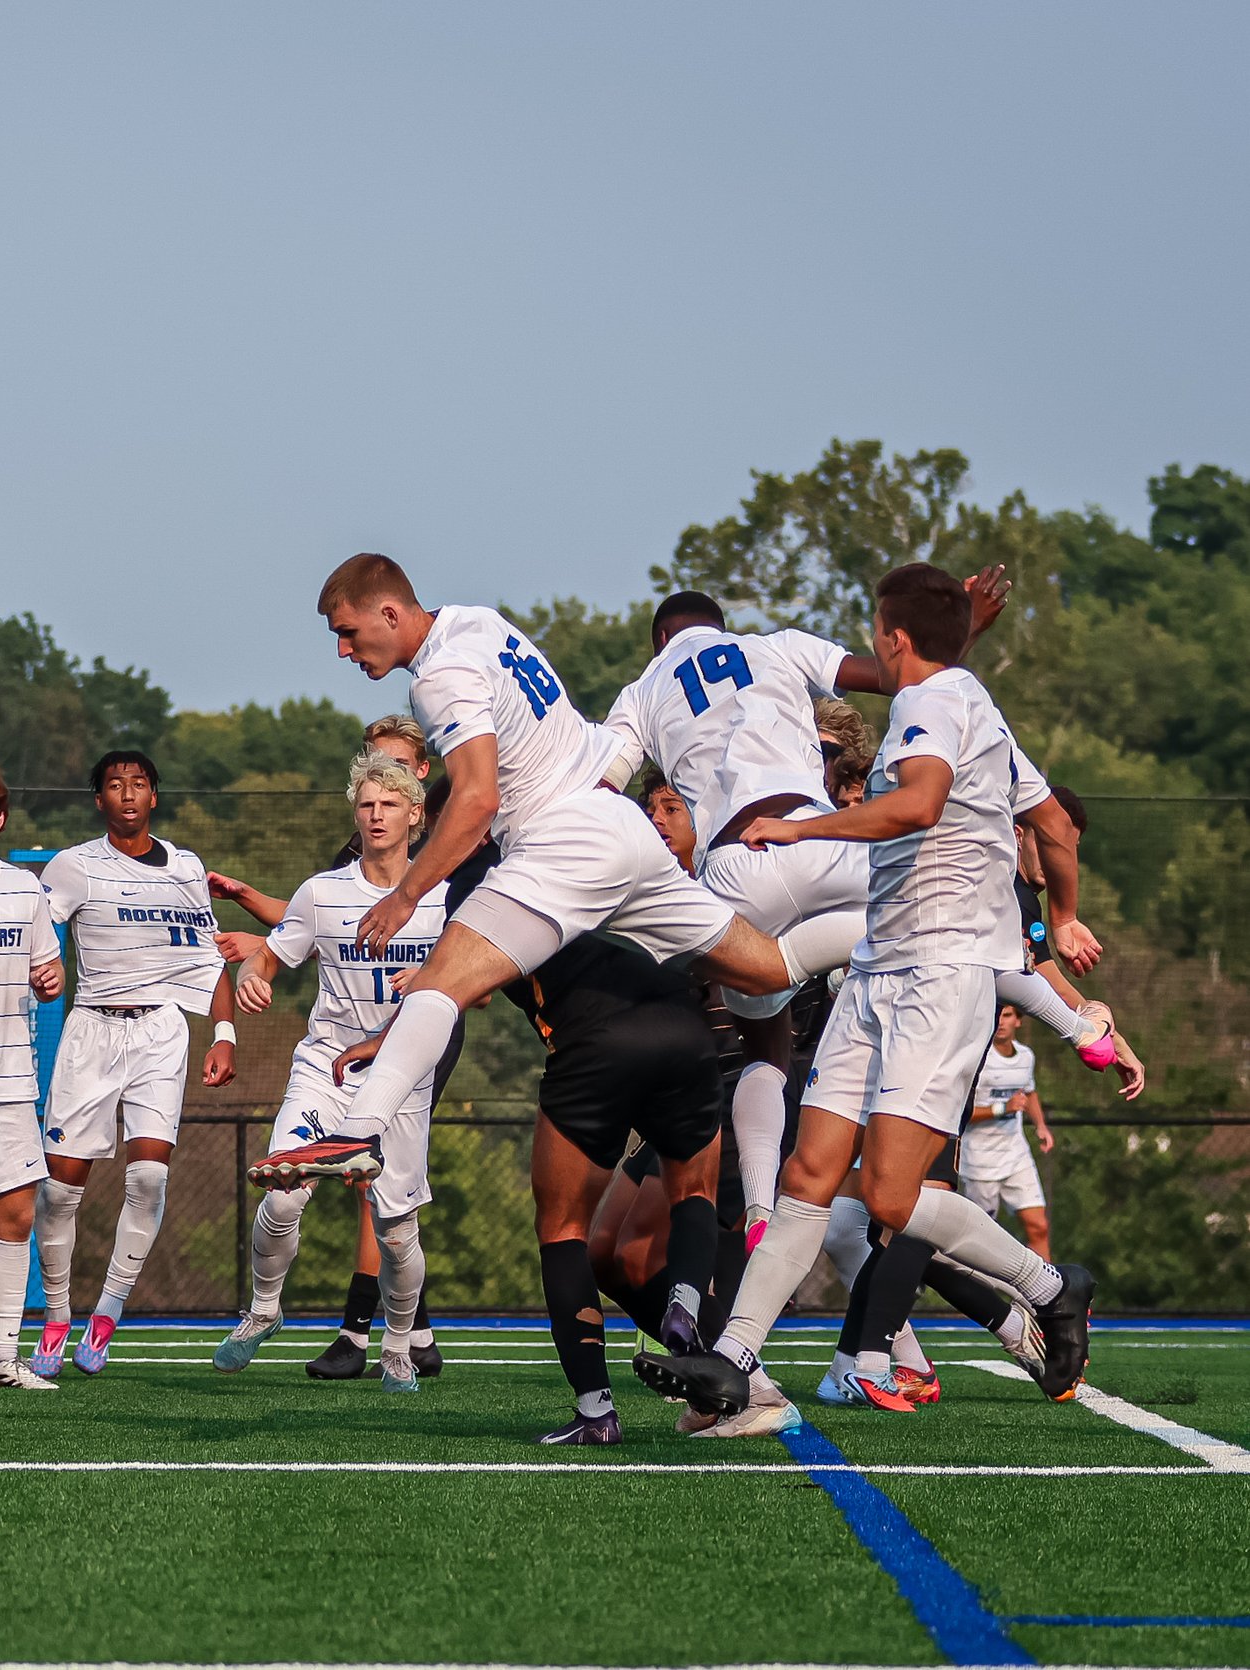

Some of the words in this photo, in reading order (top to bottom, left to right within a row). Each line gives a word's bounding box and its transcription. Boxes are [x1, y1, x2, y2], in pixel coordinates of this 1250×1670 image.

[498, 634, 561, 721] 16
[673, 642, 754, 718] 19
[117, 907, 214, 928] ROCKHURST
[168, 926, 200, 947] 11
[372, 967, 406, 1004] 17
